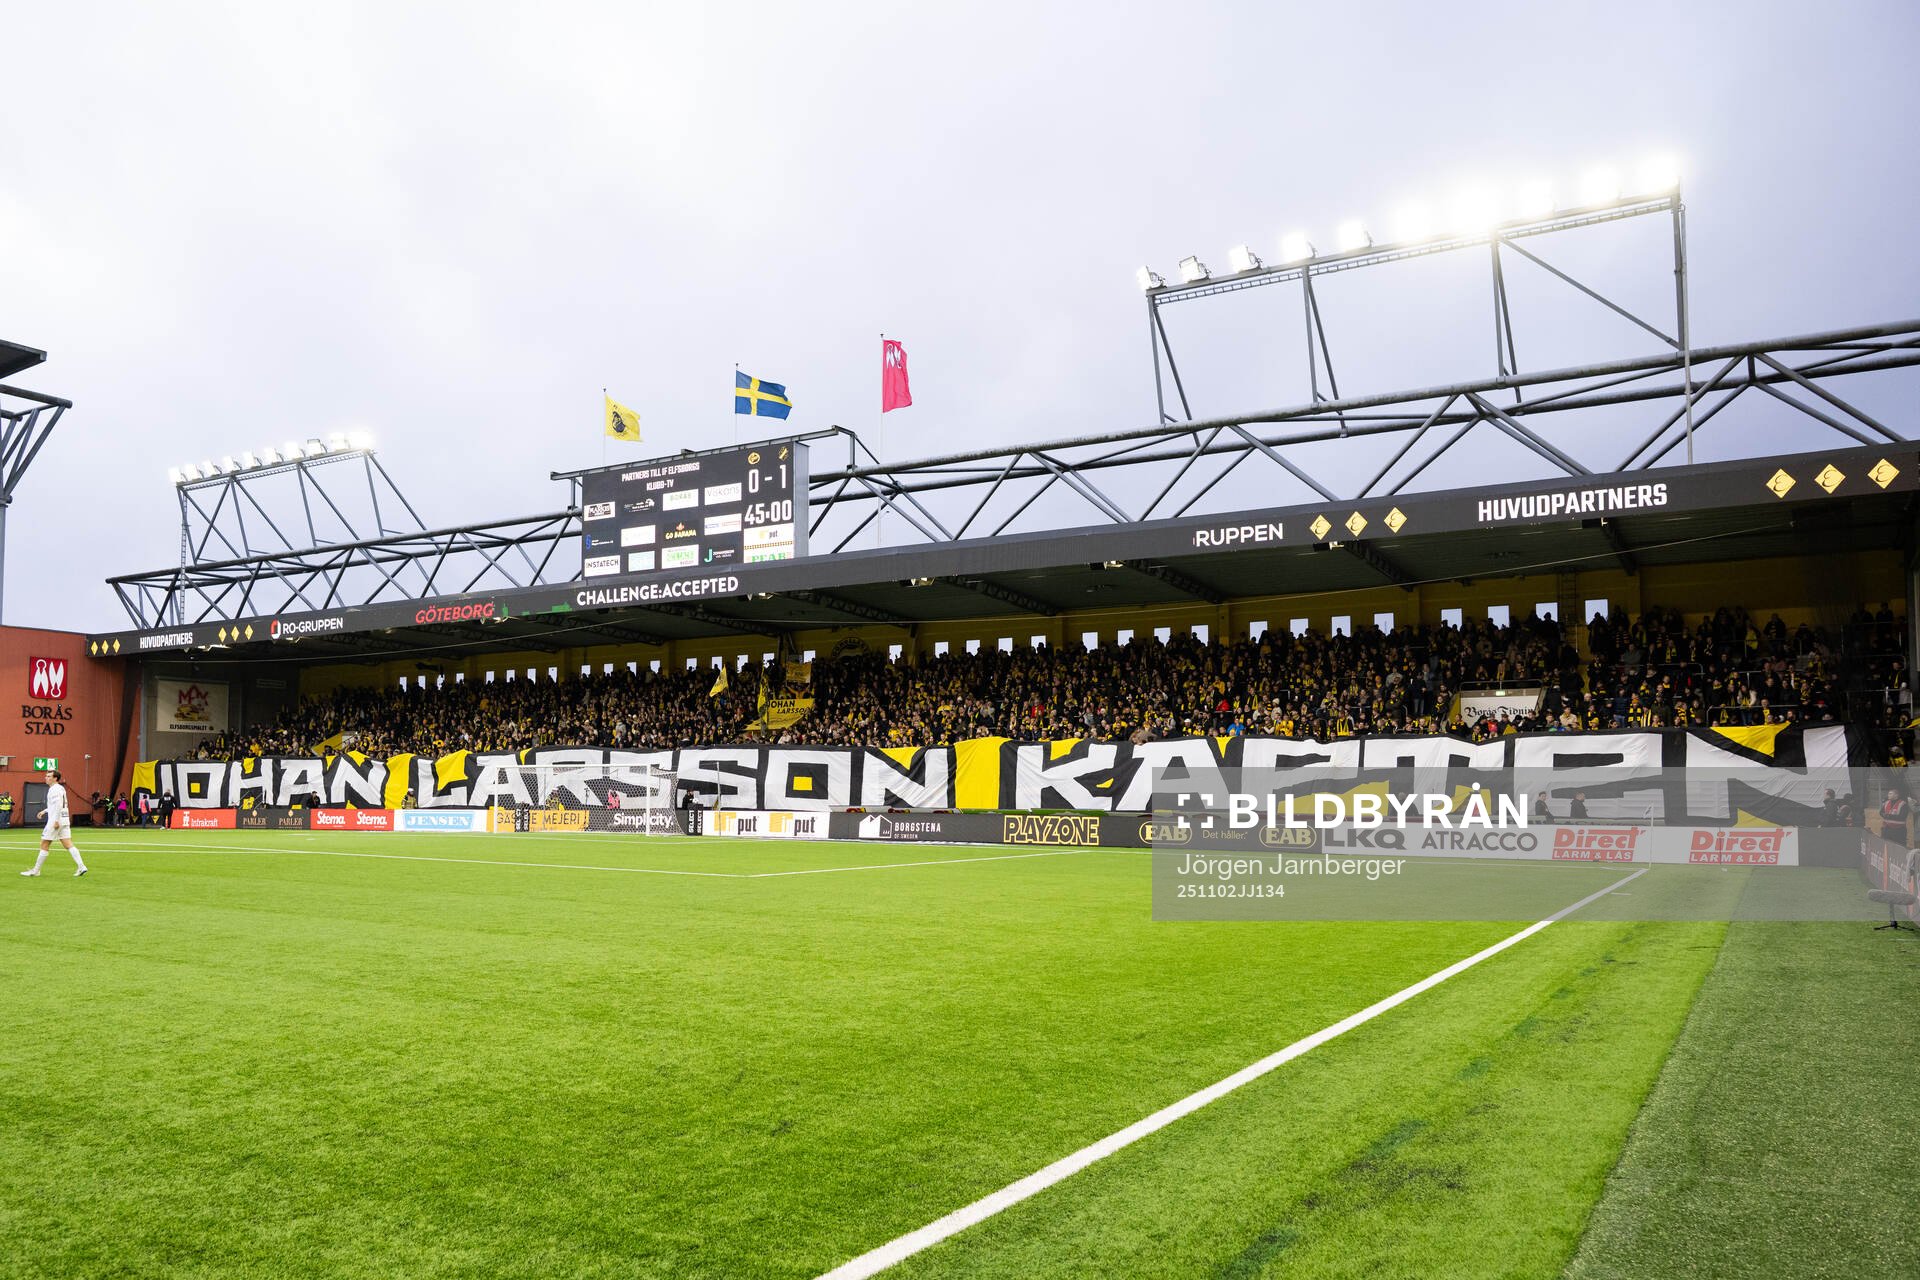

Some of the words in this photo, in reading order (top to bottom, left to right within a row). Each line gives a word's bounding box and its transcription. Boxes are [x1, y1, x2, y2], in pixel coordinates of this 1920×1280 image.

[622, 470, 650, 482] PARTNERS
[650, 468, 661, 479] TILL
[660, 467, 668, 476] IF
[668, 462, 700, 475] ELFSBORGS
[748, 469, 759, 493] 0
[779, 464, 787, 489] 1
[646, 479, 674, 491] KLUBB-TV
[1478, 483, 1668, 522] HUVUDPARTNERS
[1193, 522, 1284, 548] RUPPEN
[586, 559, 619, 569] INSTATECH
[576, 576, 739, 606] CHALLENGE:ACCEPTED
[415, 602, 494, 624] GÖTEBORG
[282, 617, 344, 634] RO-GRUPPEN
[139, 632, 193, 649] HUVUDPARTNERS
[21, 704, 73, 721] BORÅS
[24, 722, 65, 736] STAD
[137, 757, 388, 811] JOHAN
[417, 746, 949, 810] LARSSON
[1016, 724, 1853, 818] KAPTEN
[278, 817, 303, 826] PARLER
[406, 813, 470, 826] JENSEN
[543, 812, 580, 825] MEJERI
[613, 812, 674, 828] Simplcity.
[894, 822, 942, 833] BORGSTENA
[1003, 814, 1100, 846] PLAYZONE
[1144, 824, 1188, 841] EAB
[1202, 829, 1219, 839] Det
[1265, 827, 1312, 845] EAB
[1324, 827, 1408, 850] LKQ
[1421, 831, 1538, 851] ATRACCO
[1553, 850, 1591, 860] LARM
[1594, 851, 1602, 860] &
[1690, 852, 1732, 863] LARM
[1736, 853, 1744, 863] &
